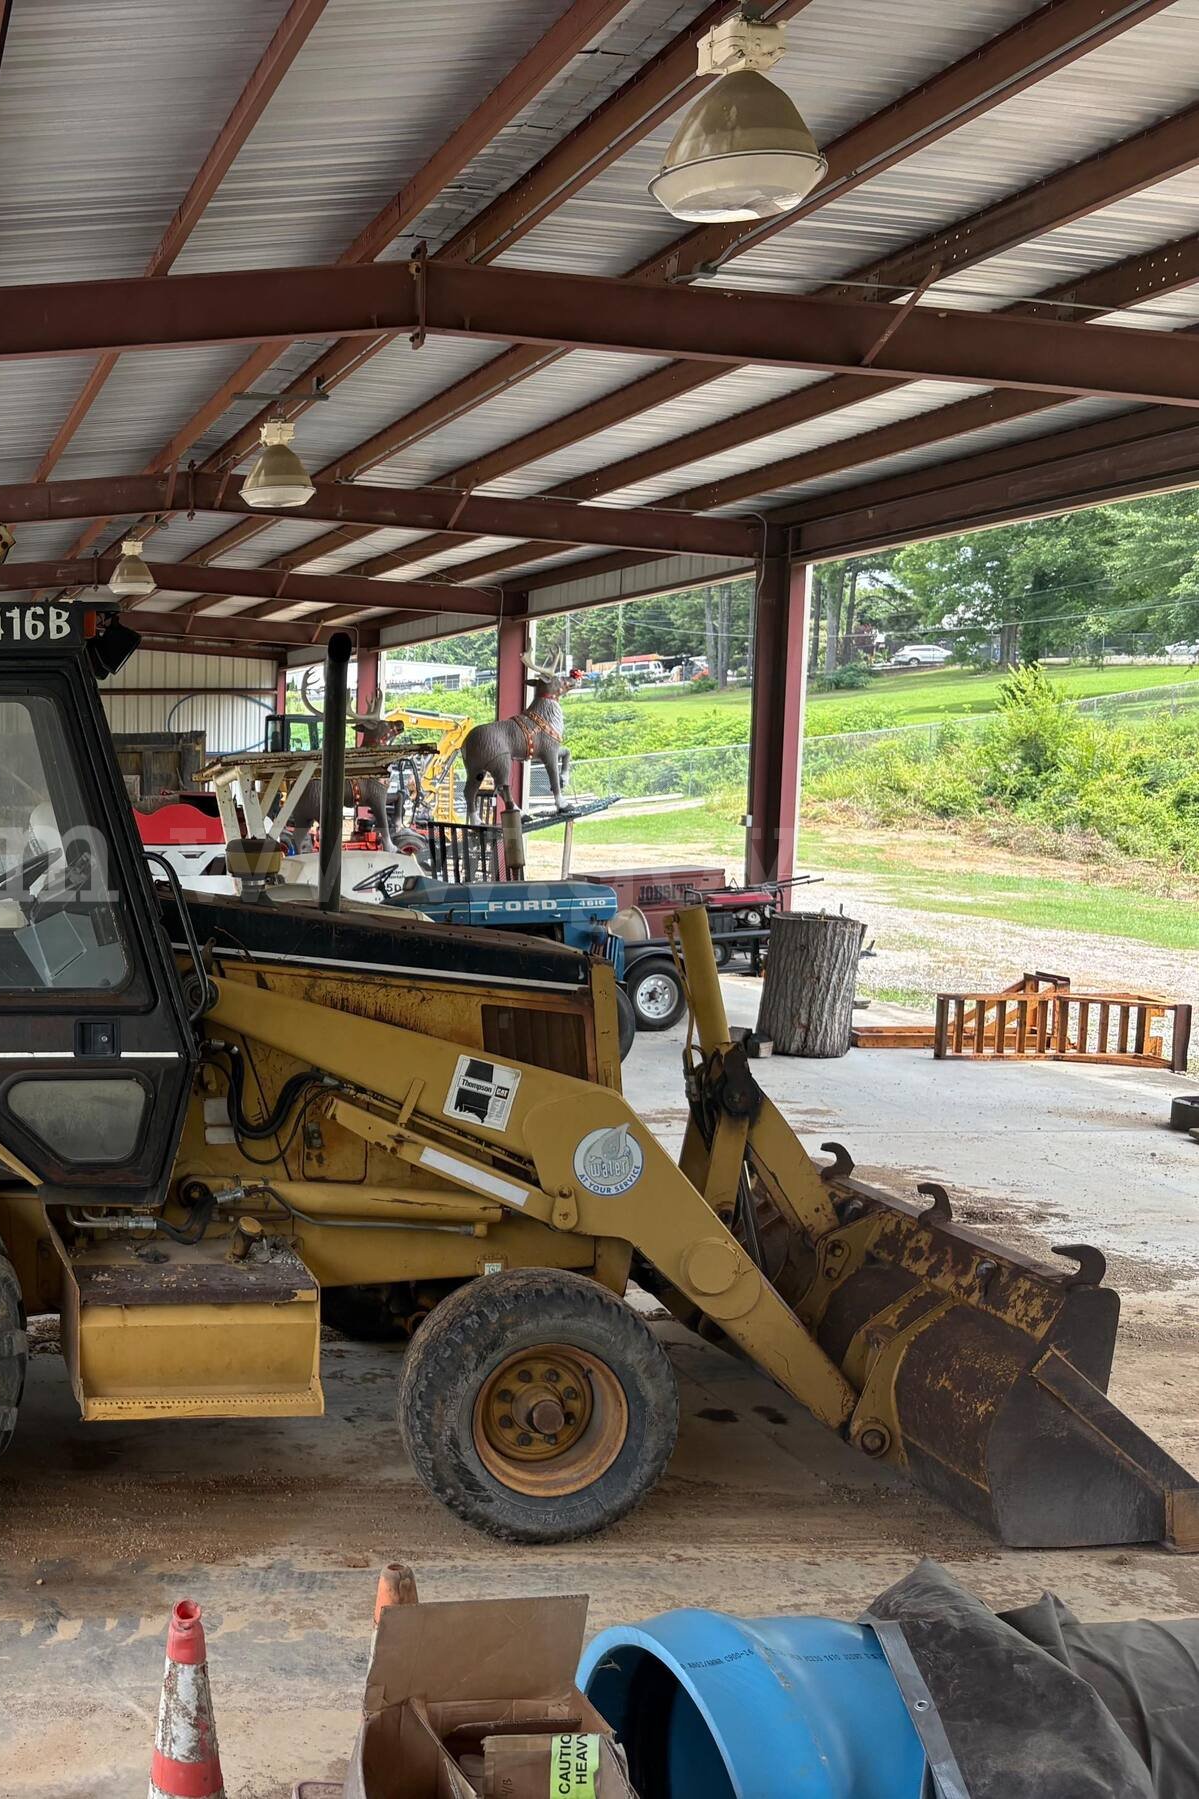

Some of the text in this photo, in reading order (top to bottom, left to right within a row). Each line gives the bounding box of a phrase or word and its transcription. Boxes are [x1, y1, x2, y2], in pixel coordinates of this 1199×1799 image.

[488, 900, 557, 912] FORD
[462, 1079, 492, 1094] Thompson
[579, 1165, 641, 1194] AT YOUR SERVICE
